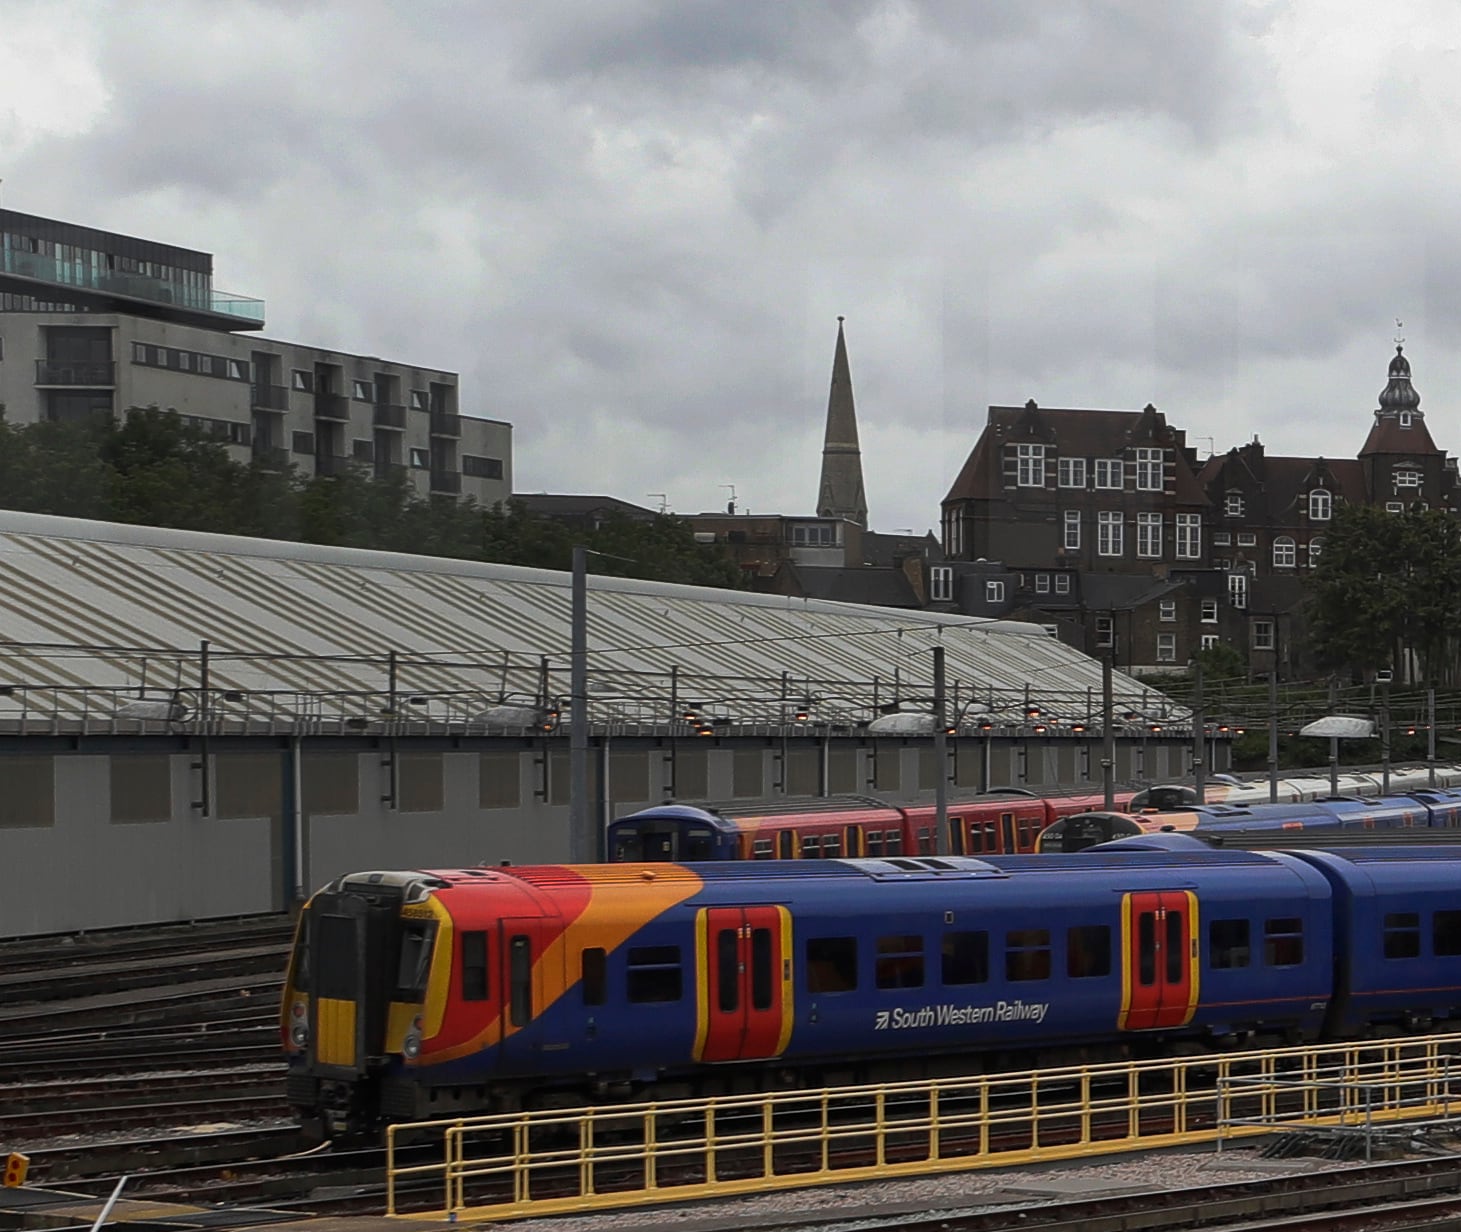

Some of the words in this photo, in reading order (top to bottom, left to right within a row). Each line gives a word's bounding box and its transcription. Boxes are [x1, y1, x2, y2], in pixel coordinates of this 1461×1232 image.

[892, 1006, 935, 1029] South
[936, 1004, 994, 1026] Western
[995, 1000, 1049, 1024] Railway
